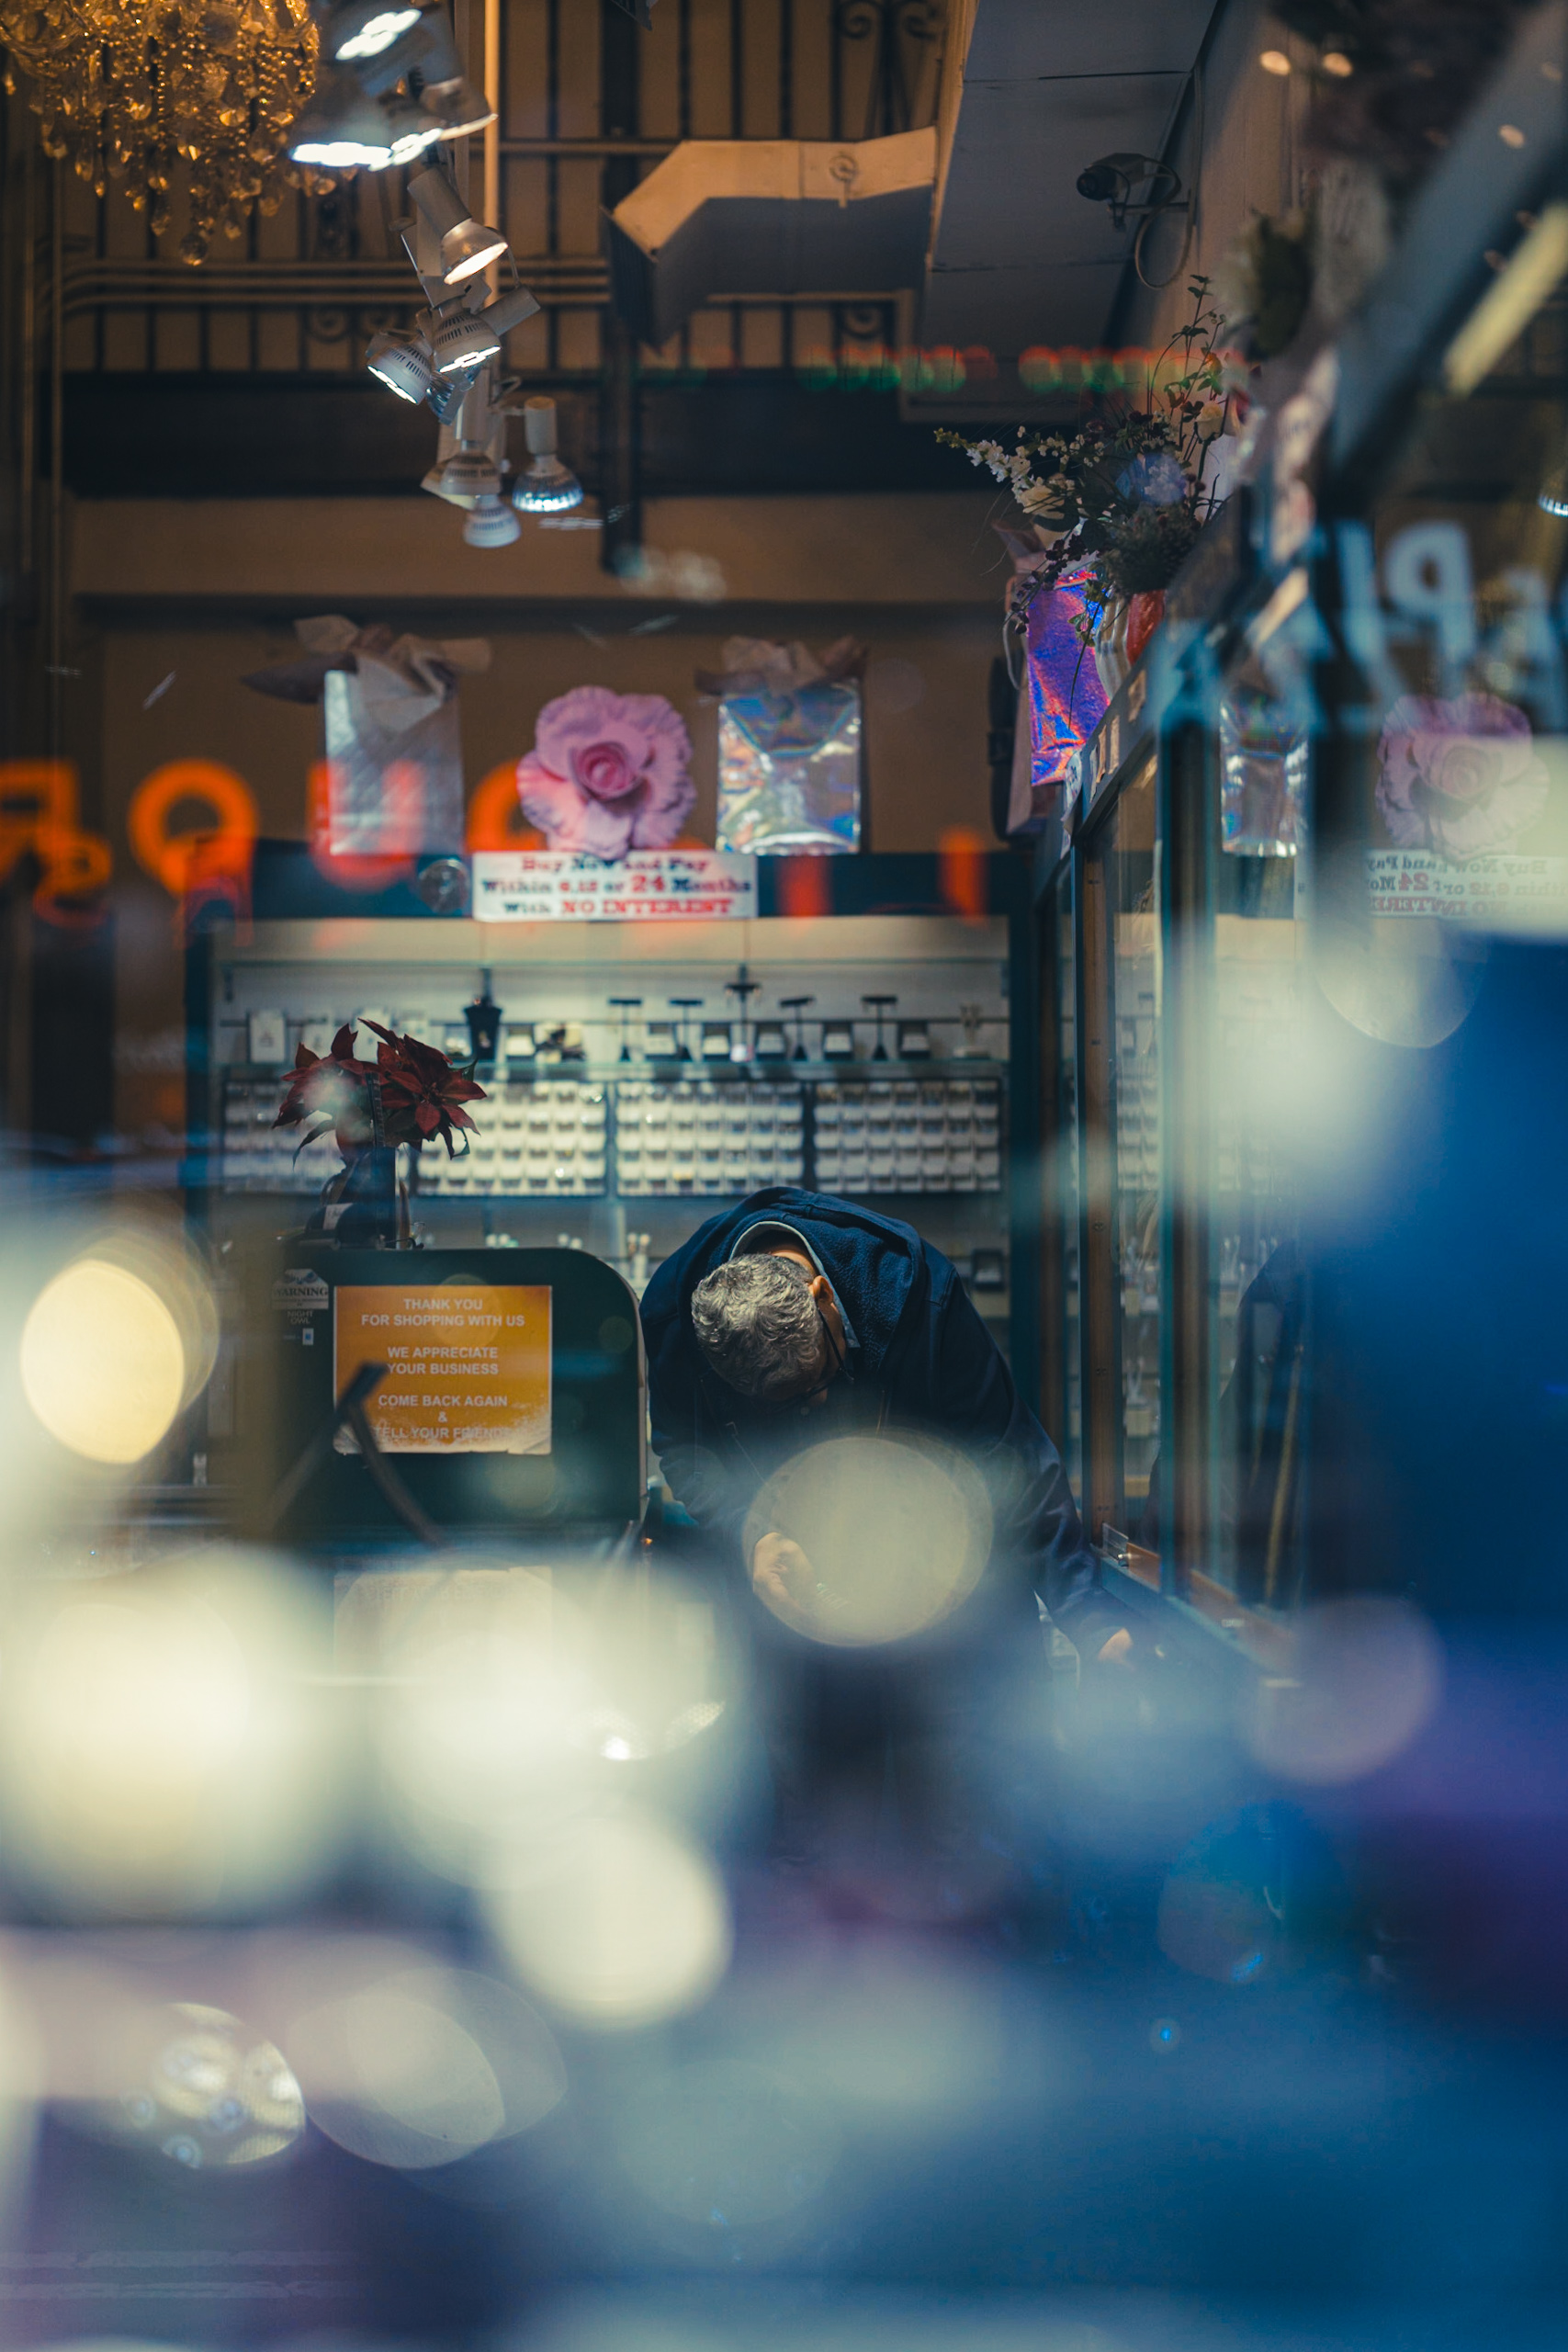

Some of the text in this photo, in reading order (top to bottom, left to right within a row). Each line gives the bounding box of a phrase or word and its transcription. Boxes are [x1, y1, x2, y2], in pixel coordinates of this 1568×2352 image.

[631, 875, 665, 893] 24
[671, 876, 752, 894] Months
[561, 899, 595, 914] NO
[603, 898, 733, 914] INTEREST
[404, 1298, 483, 1310] THANK YOU
[361, 1315, 525, 1327] FOR SHOPPING WITH US
[388, 1347, 498, 1359] WE APPRECIATE
[388, 1363, 499, 1375] YOUR BUSINESS
[378, 1395, 508, 1407] COME BACK AGAIN
[437, 1411, 448, 1423] &
[375, 1427, 410, 1439] TELL
[412, 1427, 449, 1439] YOUR
